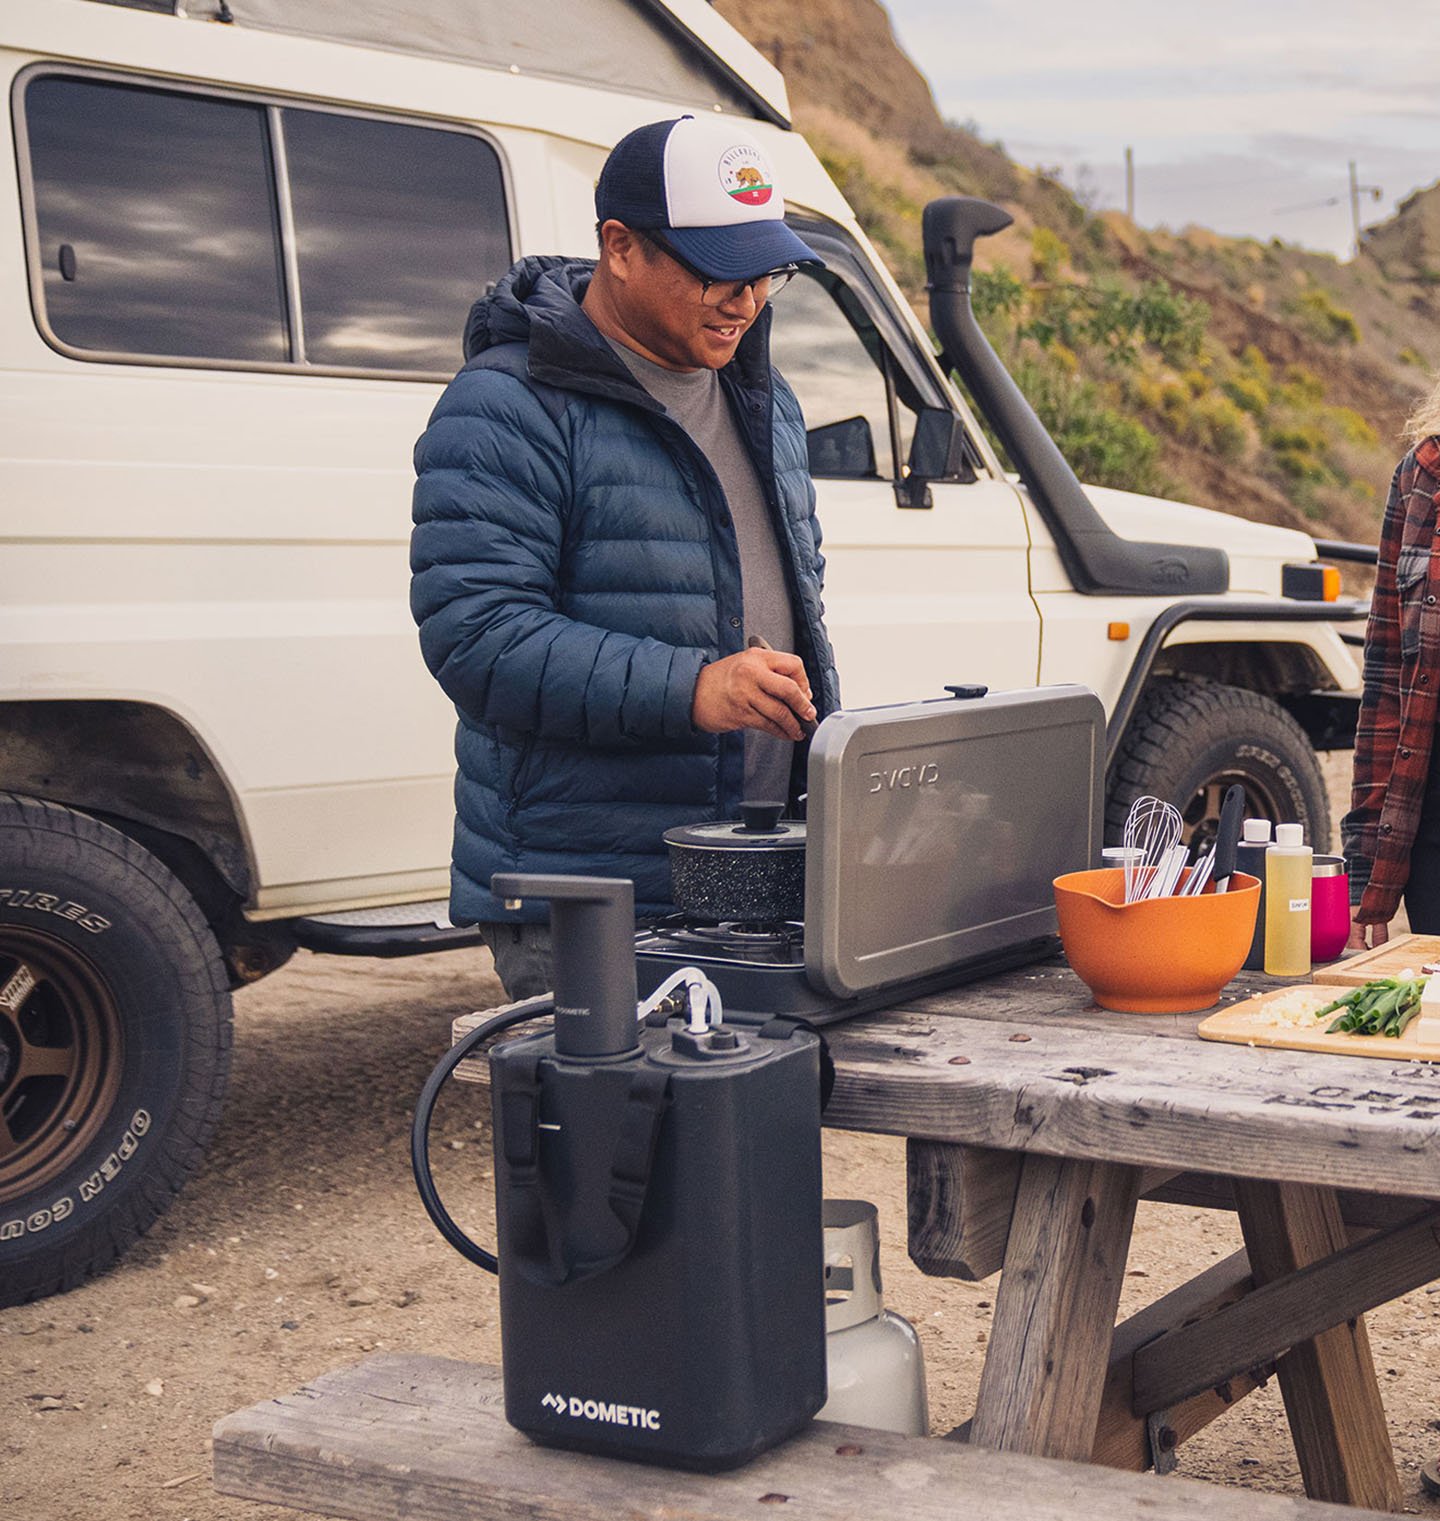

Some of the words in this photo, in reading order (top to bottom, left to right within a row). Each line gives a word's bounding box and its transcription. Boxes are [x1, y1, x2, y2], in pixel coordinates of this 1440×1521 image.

[79, 1108, 151, 1202] OPEN
[0, 1196, 74, 1240] COU
[569, 1397, 661, 1430] DOMETIC
